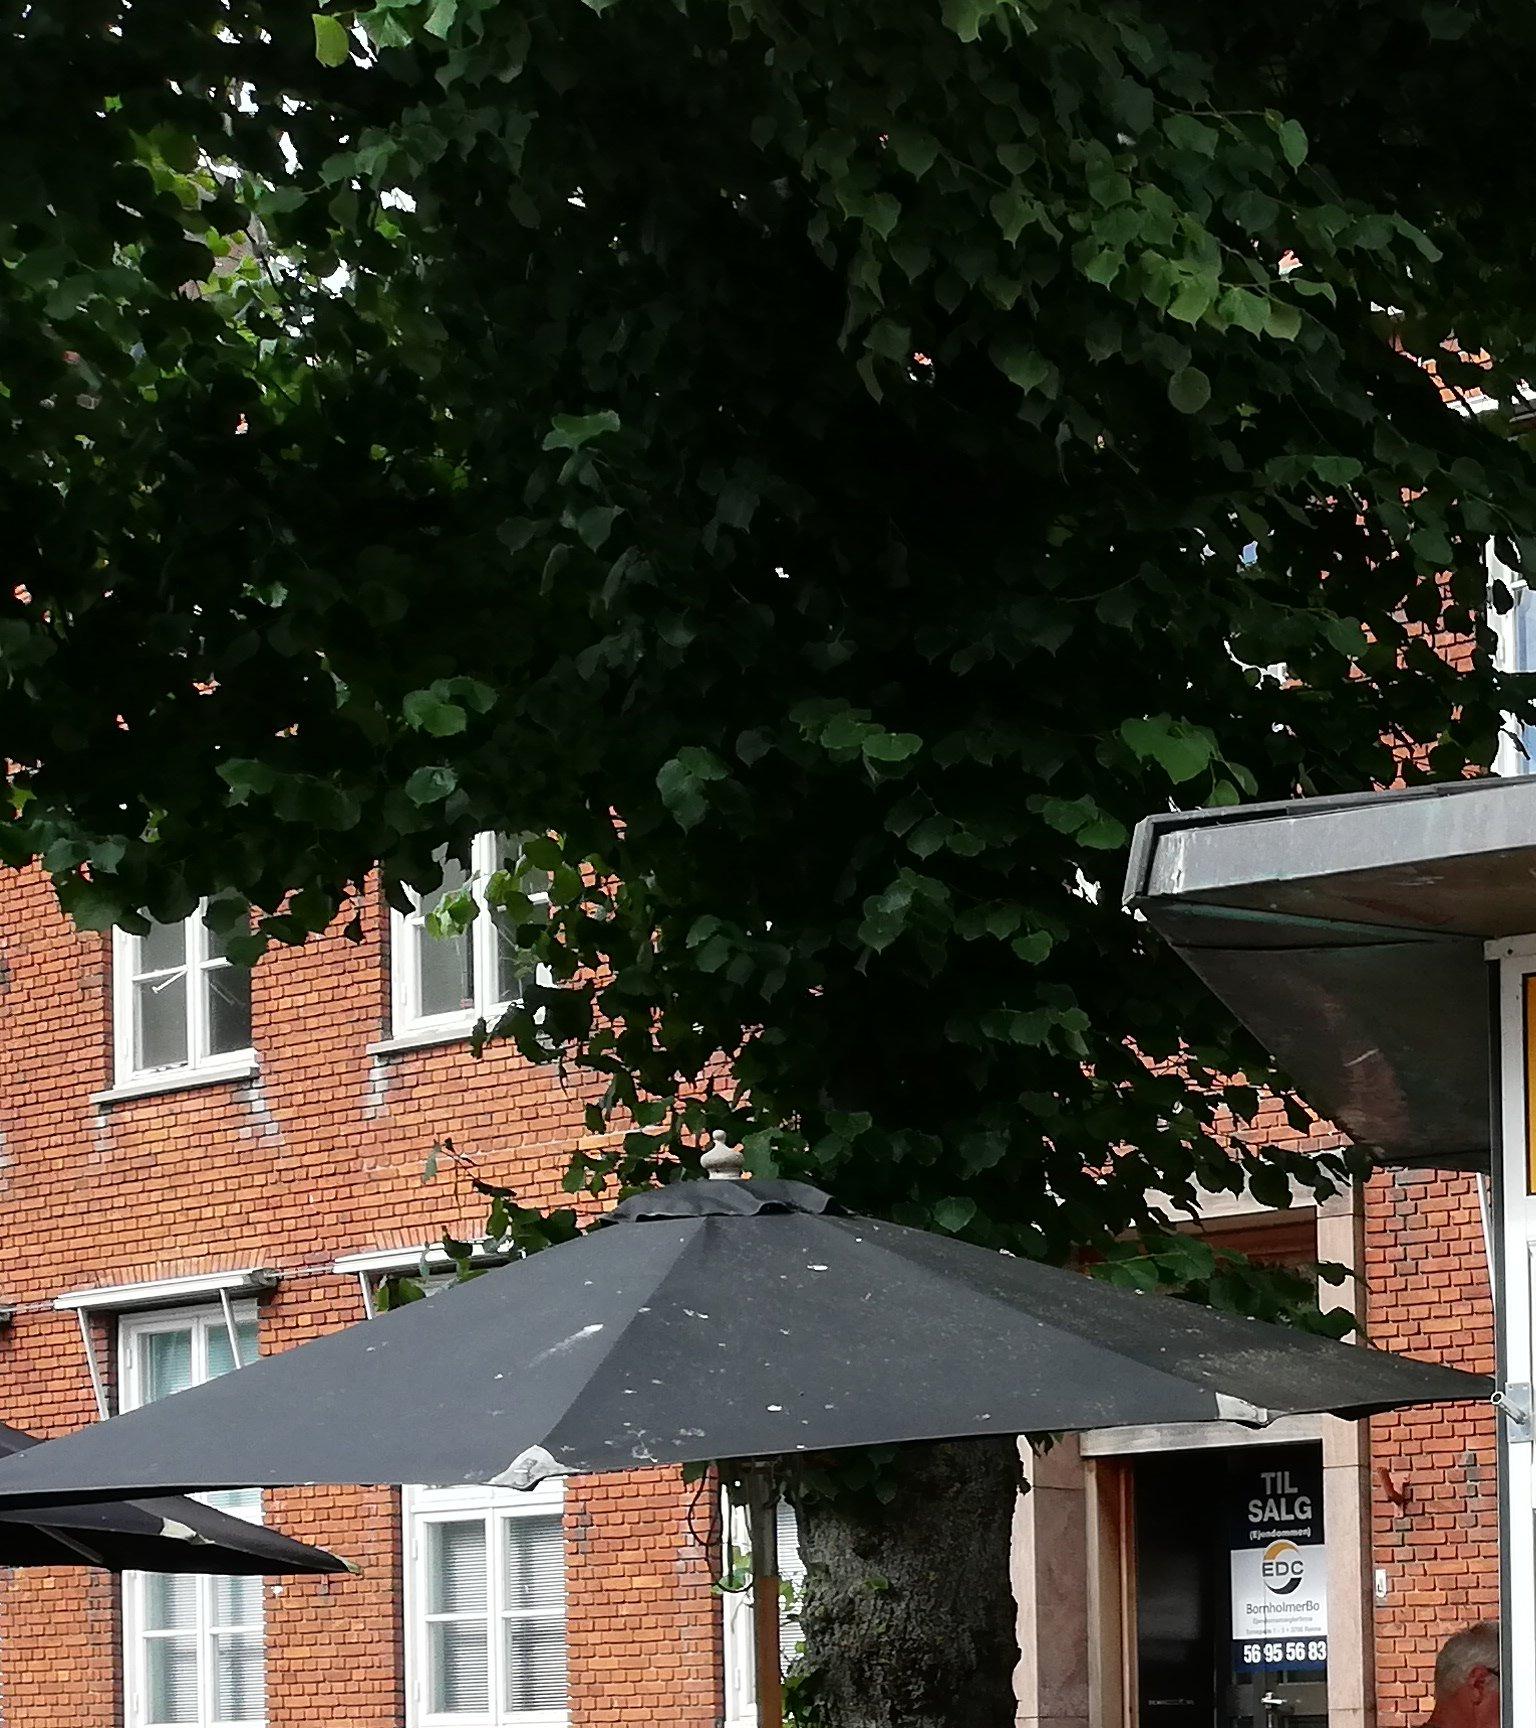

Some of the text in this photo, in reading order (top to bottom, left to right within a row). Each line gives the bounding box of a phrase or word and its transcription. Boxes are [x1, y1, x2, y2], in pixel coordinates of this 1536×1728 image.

[1260, 1471, 1298, 1495] TIL
[1248, 1496, 1313, 1523] SALG
[1262, 1561, 1304, 1577] EDC
[1246, 1600, 1320, 1615] BornholmerBo
[1243, 1640, 1327, 1663] 56 95 56 83
